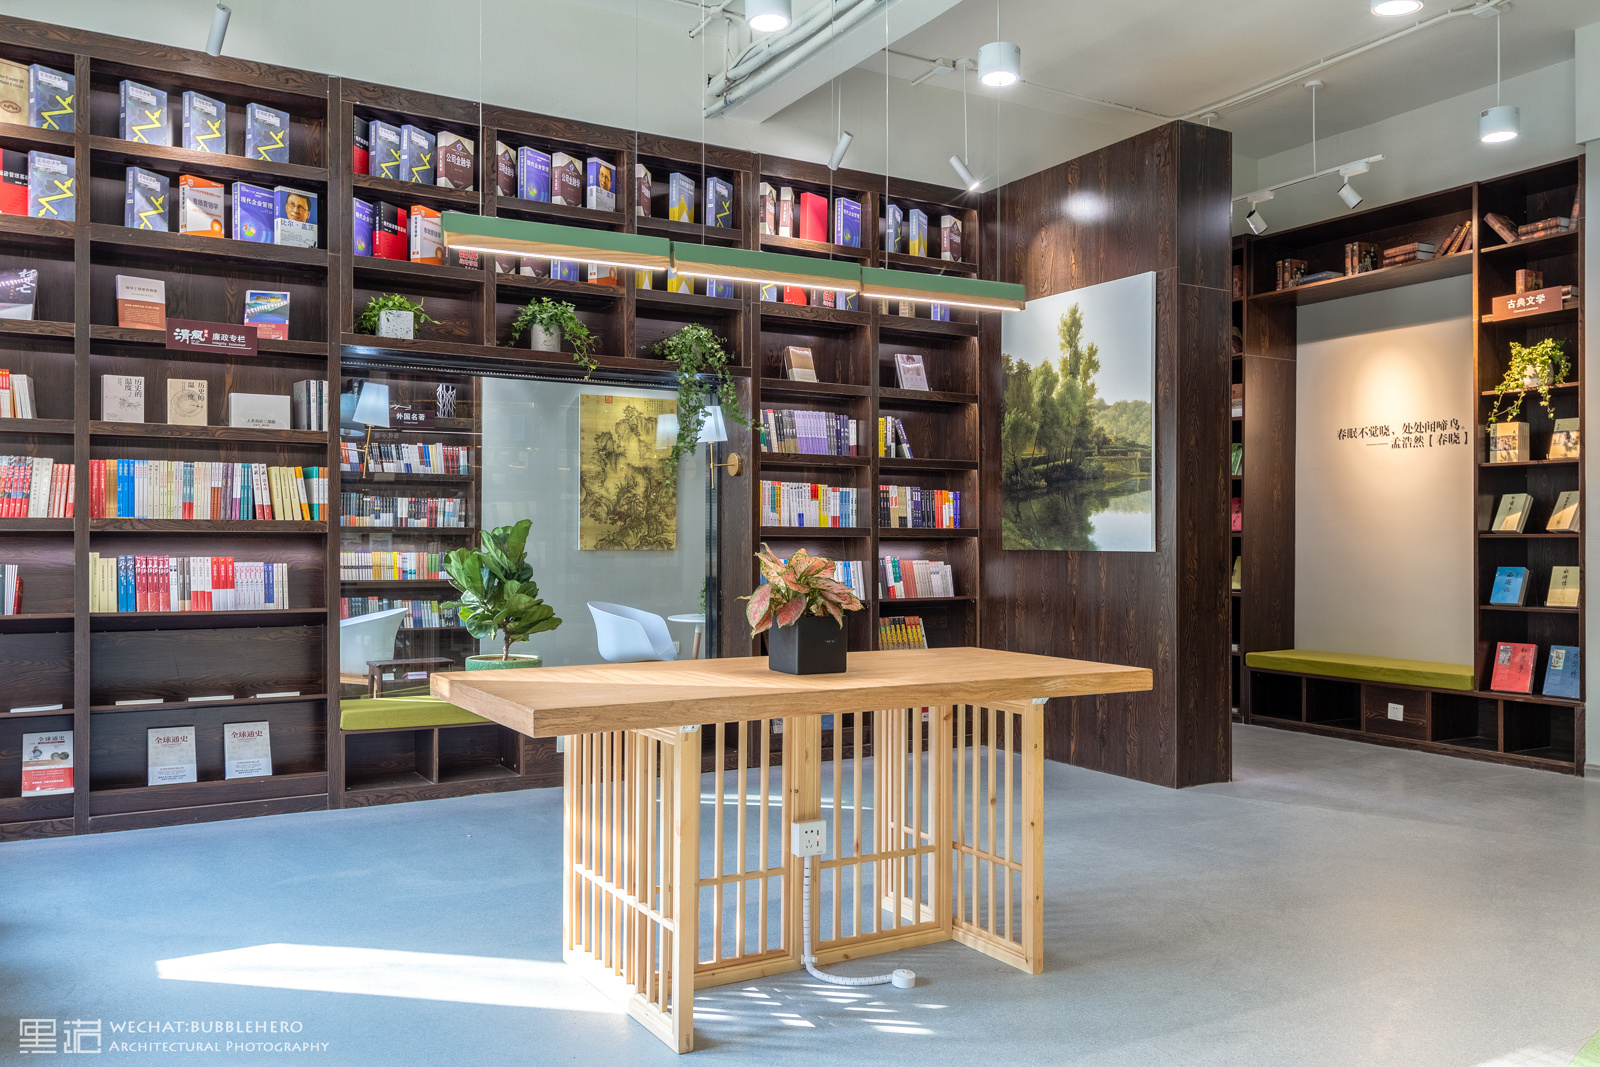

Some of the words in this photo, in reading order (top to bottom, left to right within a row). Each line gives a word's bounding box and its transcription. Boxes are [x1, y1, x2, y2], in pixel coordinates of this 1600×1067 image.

[446, 154, 472, 168] 公司金融学
[192, 198, 219, 210] 市场营销学
[240, 196, 274, 210] 现代企业管理
[1507, 294, 1546, 309] 古典文学
[212, 333, 246, 342] 廉政专栏
[134, 378, 142, 398] 历史的
[396, 412, 426, 421] 外国名著
[154, 734, 188, 744] 全球通史
[231, 730, 263, 738] 全球通史
